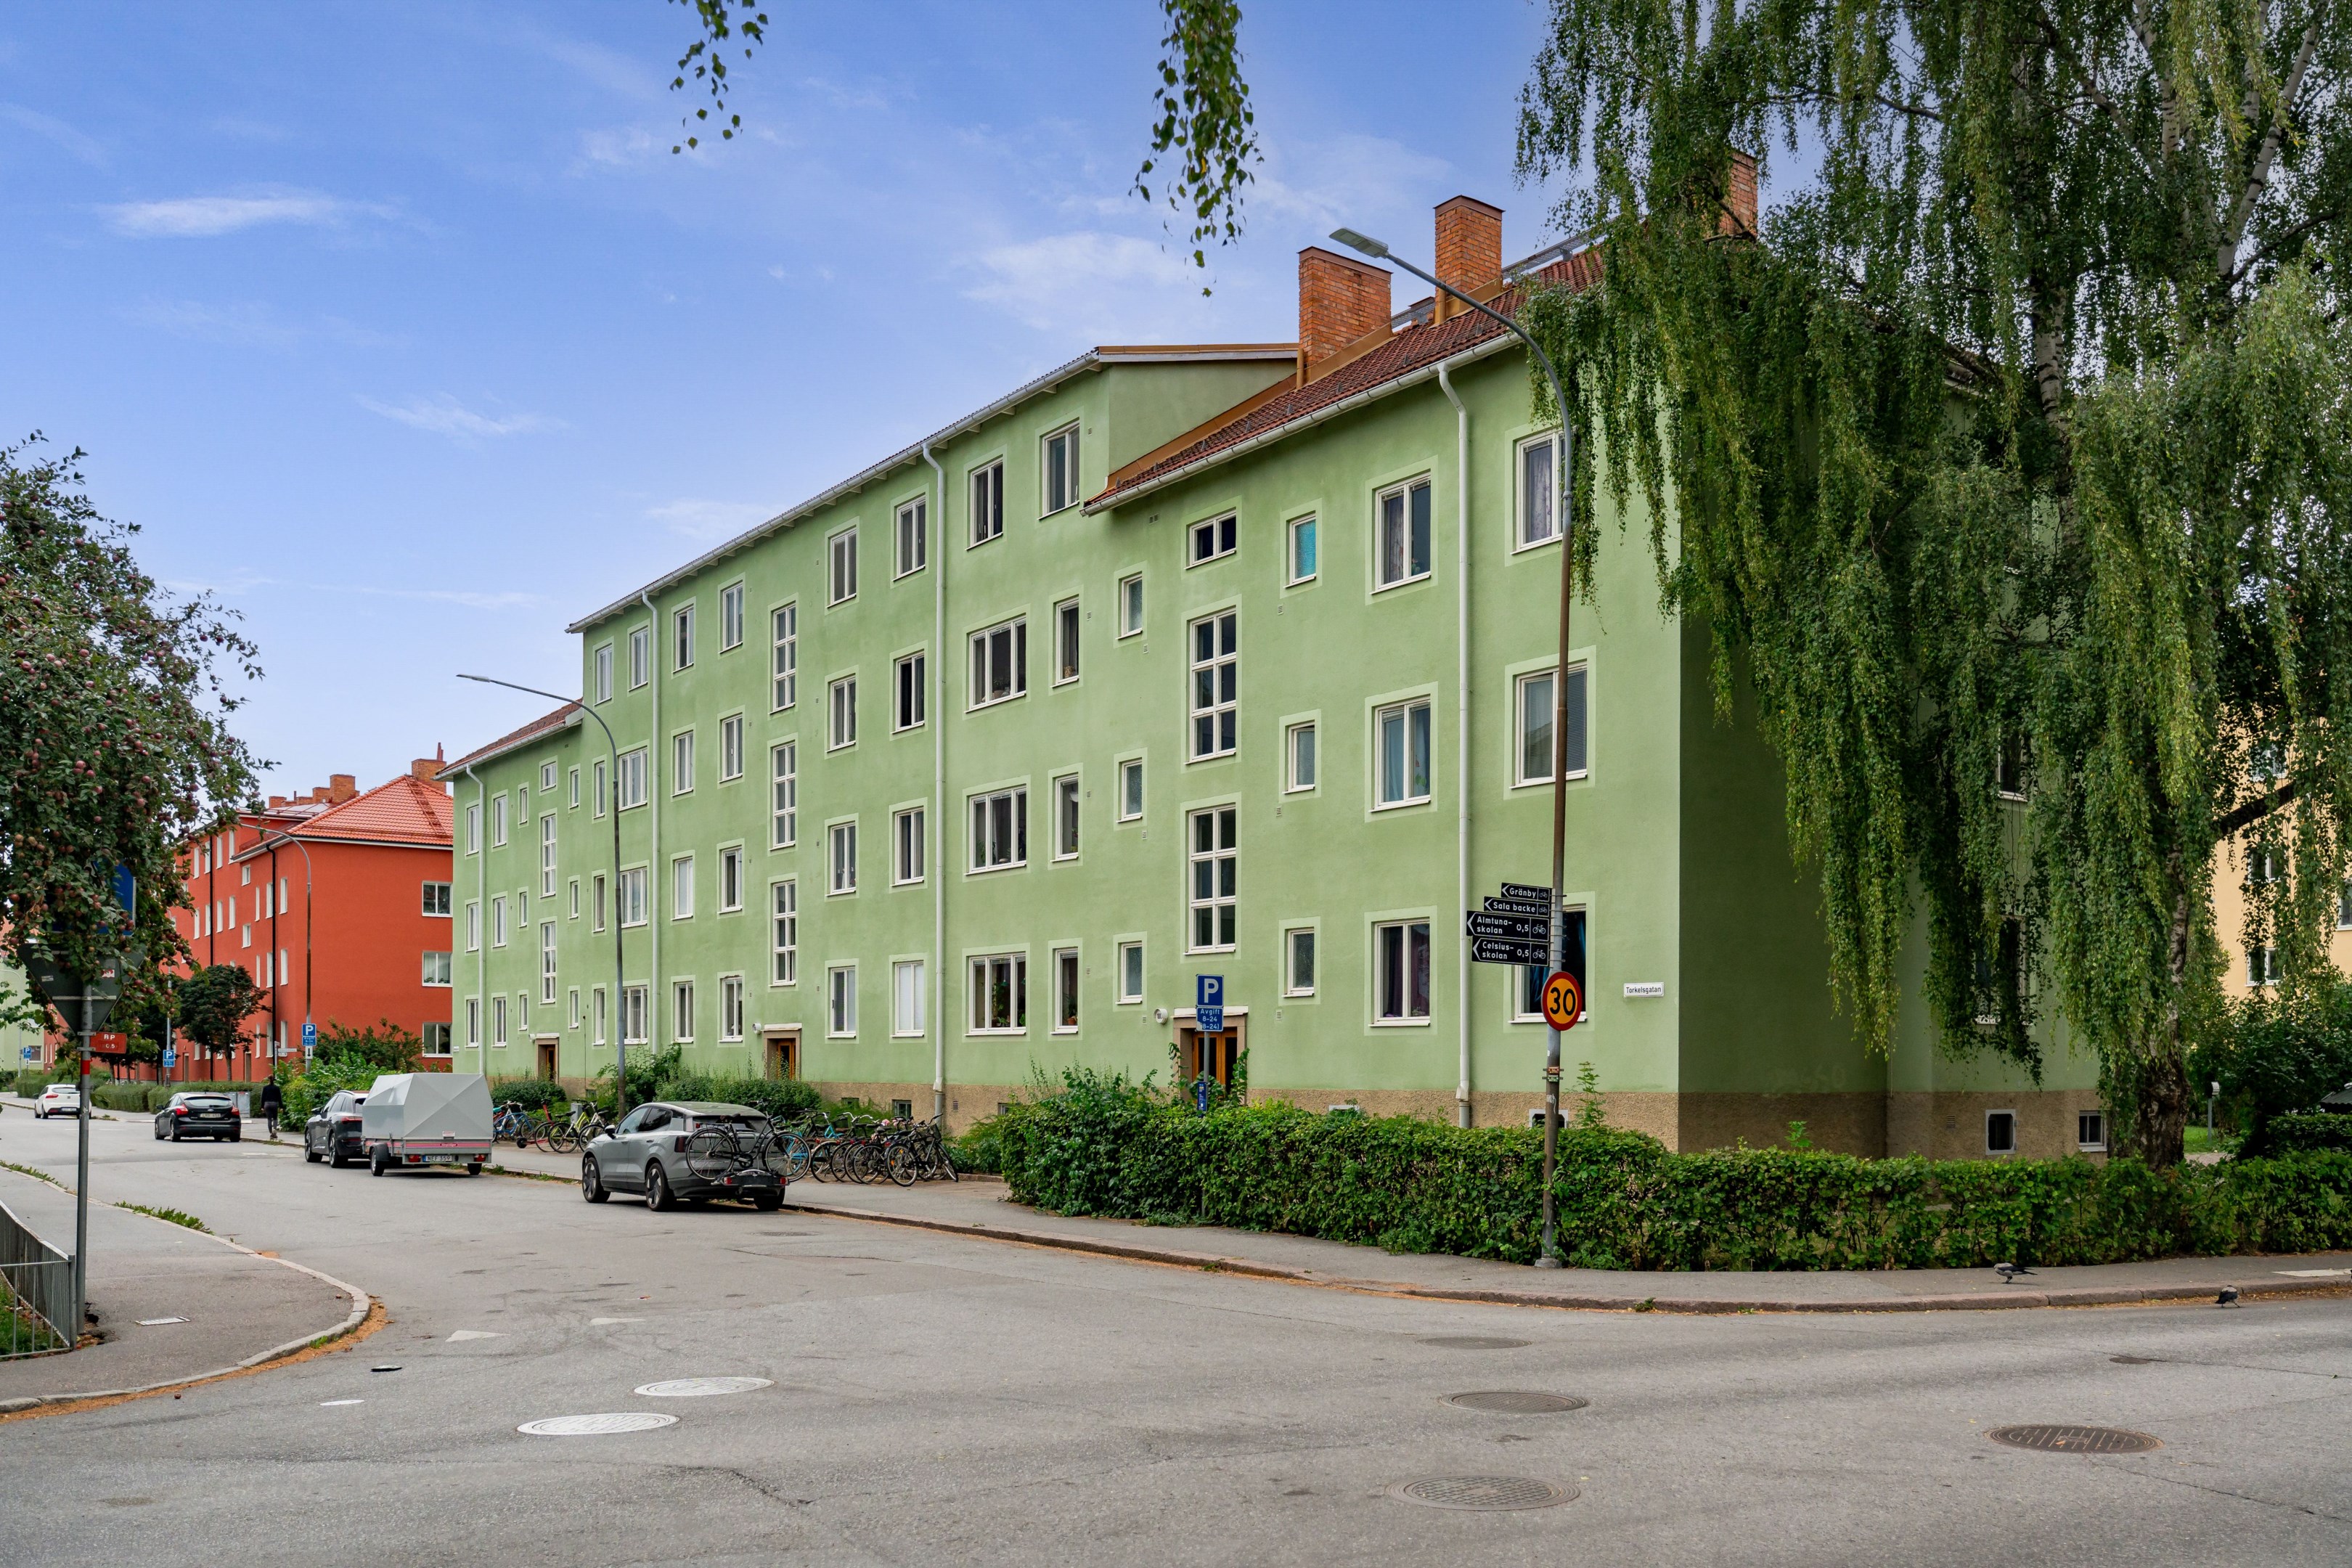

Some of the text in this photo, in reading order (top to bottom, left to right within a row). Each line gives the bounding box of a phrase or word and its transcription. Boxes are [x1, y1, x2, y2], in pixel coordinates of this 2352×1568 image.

[1510, 888, 1536, 899] Gränby
[1493, 902, 1535, 912] Sala backe
[1477, 916, 1512, 926] Almtuna-
[1516, 924, 1529, 933] 0,5
[1482, 942, 1514, 950] Celsius-
[1482, 951, 1507, 960] skolan
[1516, 949, 1529, 957] 0,5
[1204, 978, 1219, 1003] P
[1549, 987, 1576, 1016] 30
[306, 1025, 314, 1035] P
